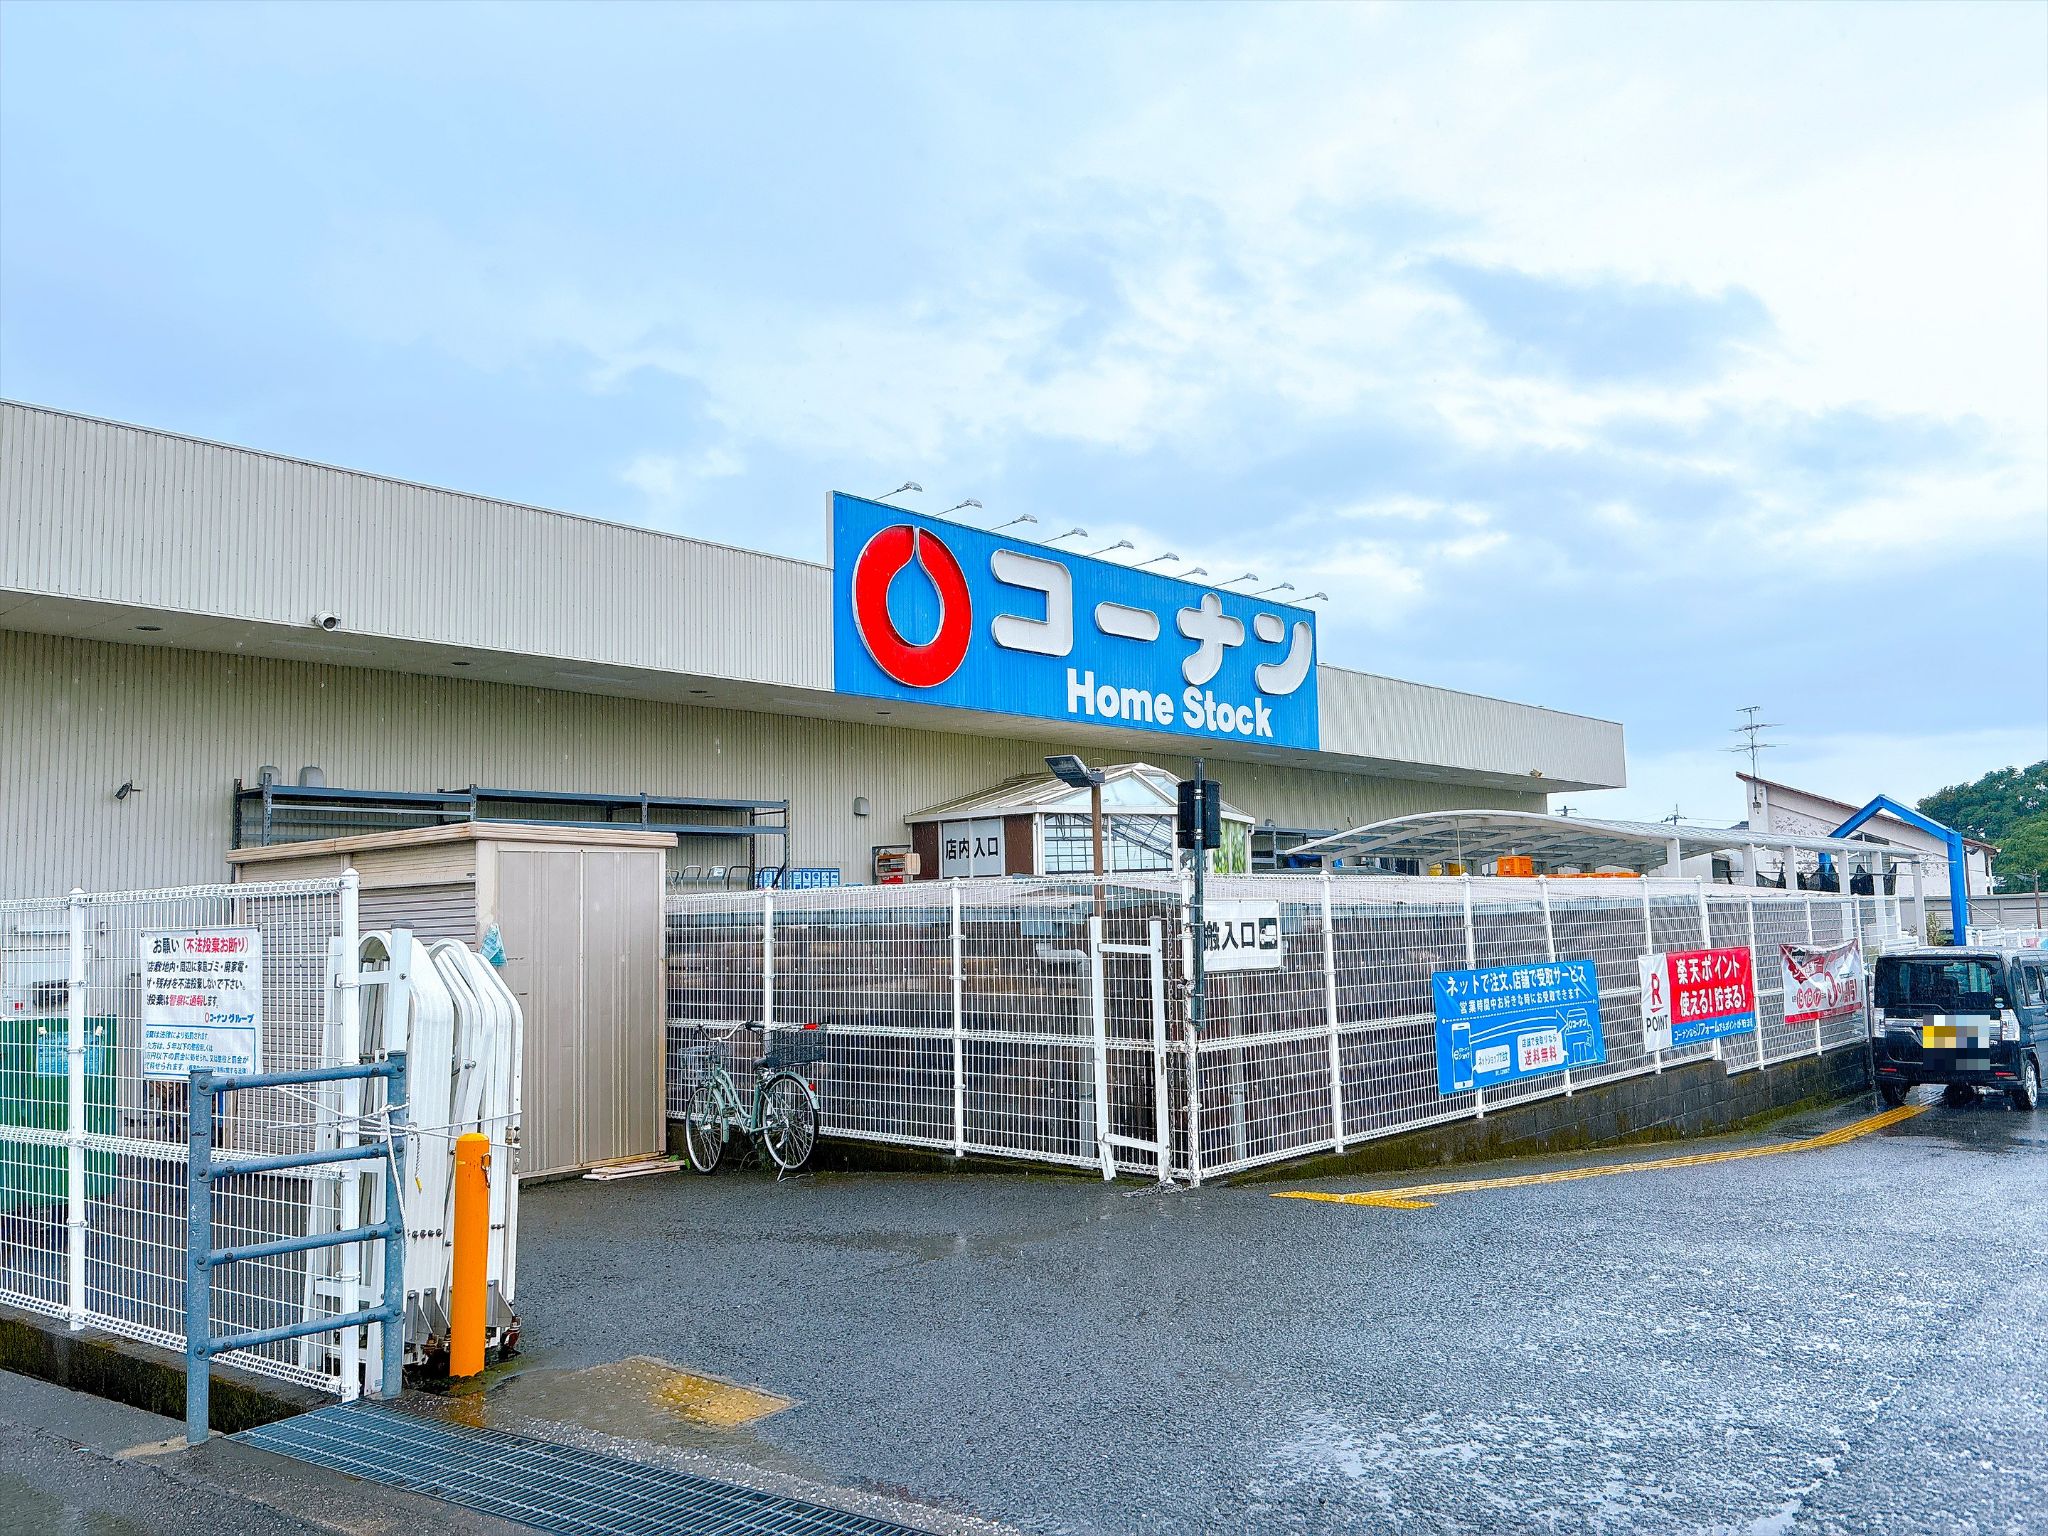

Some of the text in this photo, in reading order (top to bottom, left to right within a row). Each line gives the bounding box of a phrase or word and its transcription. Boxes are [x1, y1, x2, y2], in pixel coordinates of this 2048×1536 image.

[991, 548, 1312, 695] コーナン
[1067, 668, 1273, 738] Home Stock
[945, 837, 999, 860] 店内入口
[153, 938, 179, 954] お願い
[1447, 965, 1587, 997] ネットで注文、店舗で受取サービス
[1676, 954, 1740, 984] 楽天ポイント
[1460, 987, 1580, 1014] 営業時間中お好きな時にお受取できます
[1646, 1014, 1668, 1033] POINT
[1524, 1045, 1557, 1066] 送料無料
